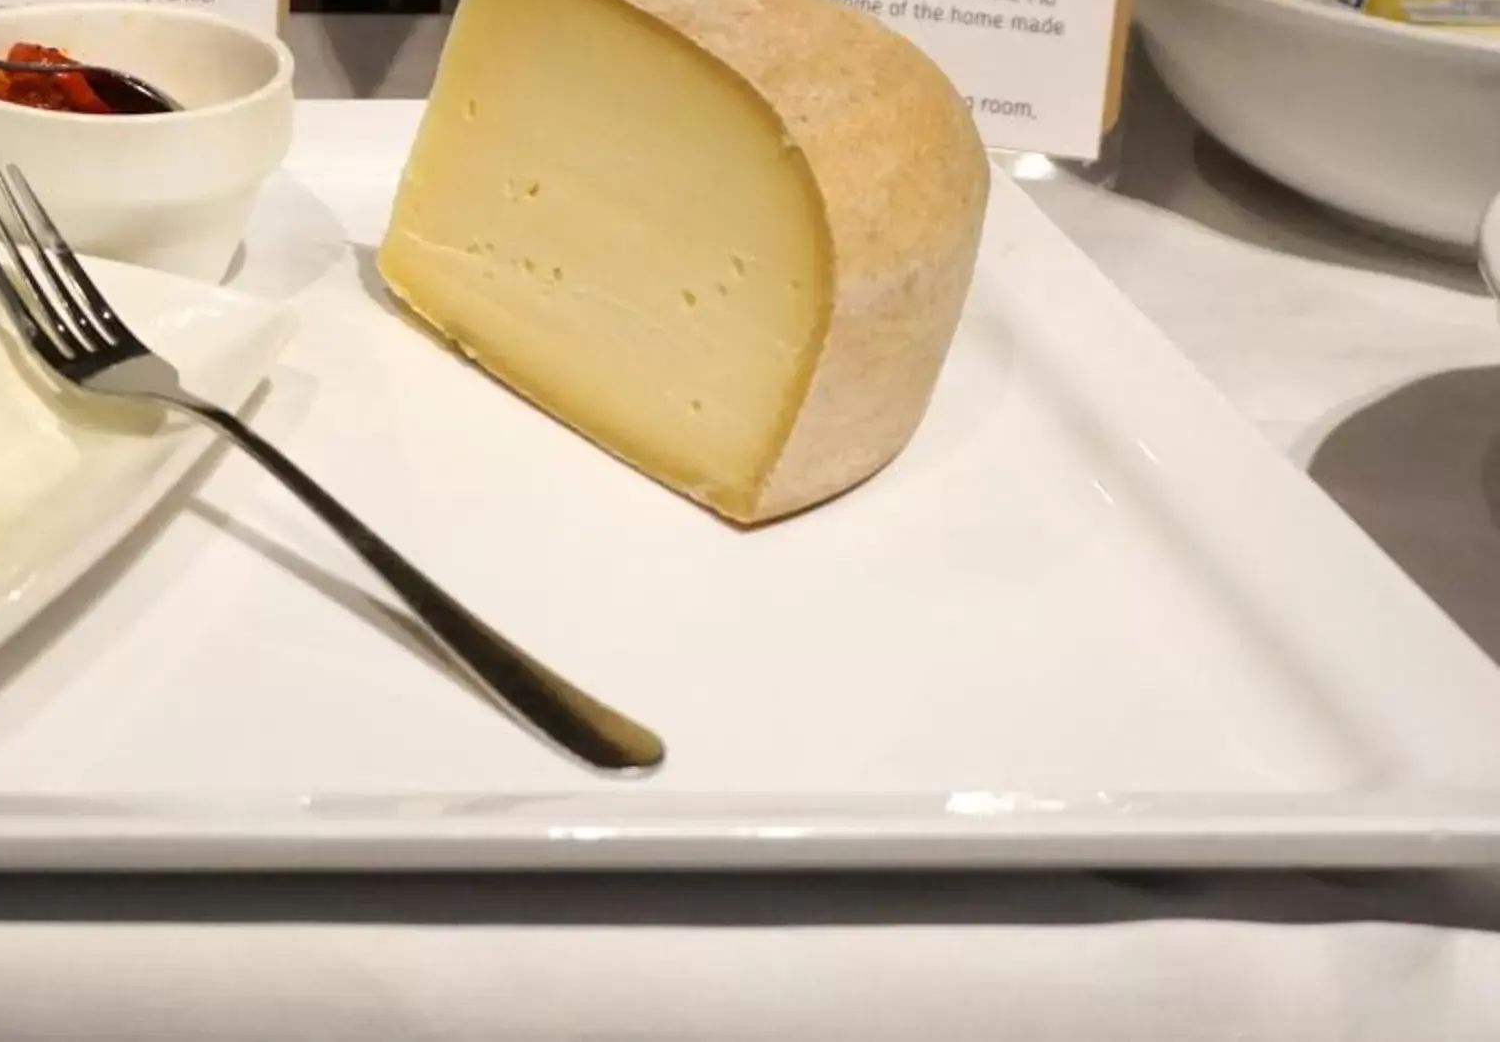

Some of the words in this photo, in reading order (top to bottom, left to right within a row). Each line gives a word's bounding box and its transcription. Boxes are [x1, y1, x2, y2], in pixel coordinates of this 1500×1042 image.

[889, 0, 906, 18] of
[912, 3, 944, 22] the
[950, 6, 1003, 28] home
[1010, 16, 1064, 35] made
